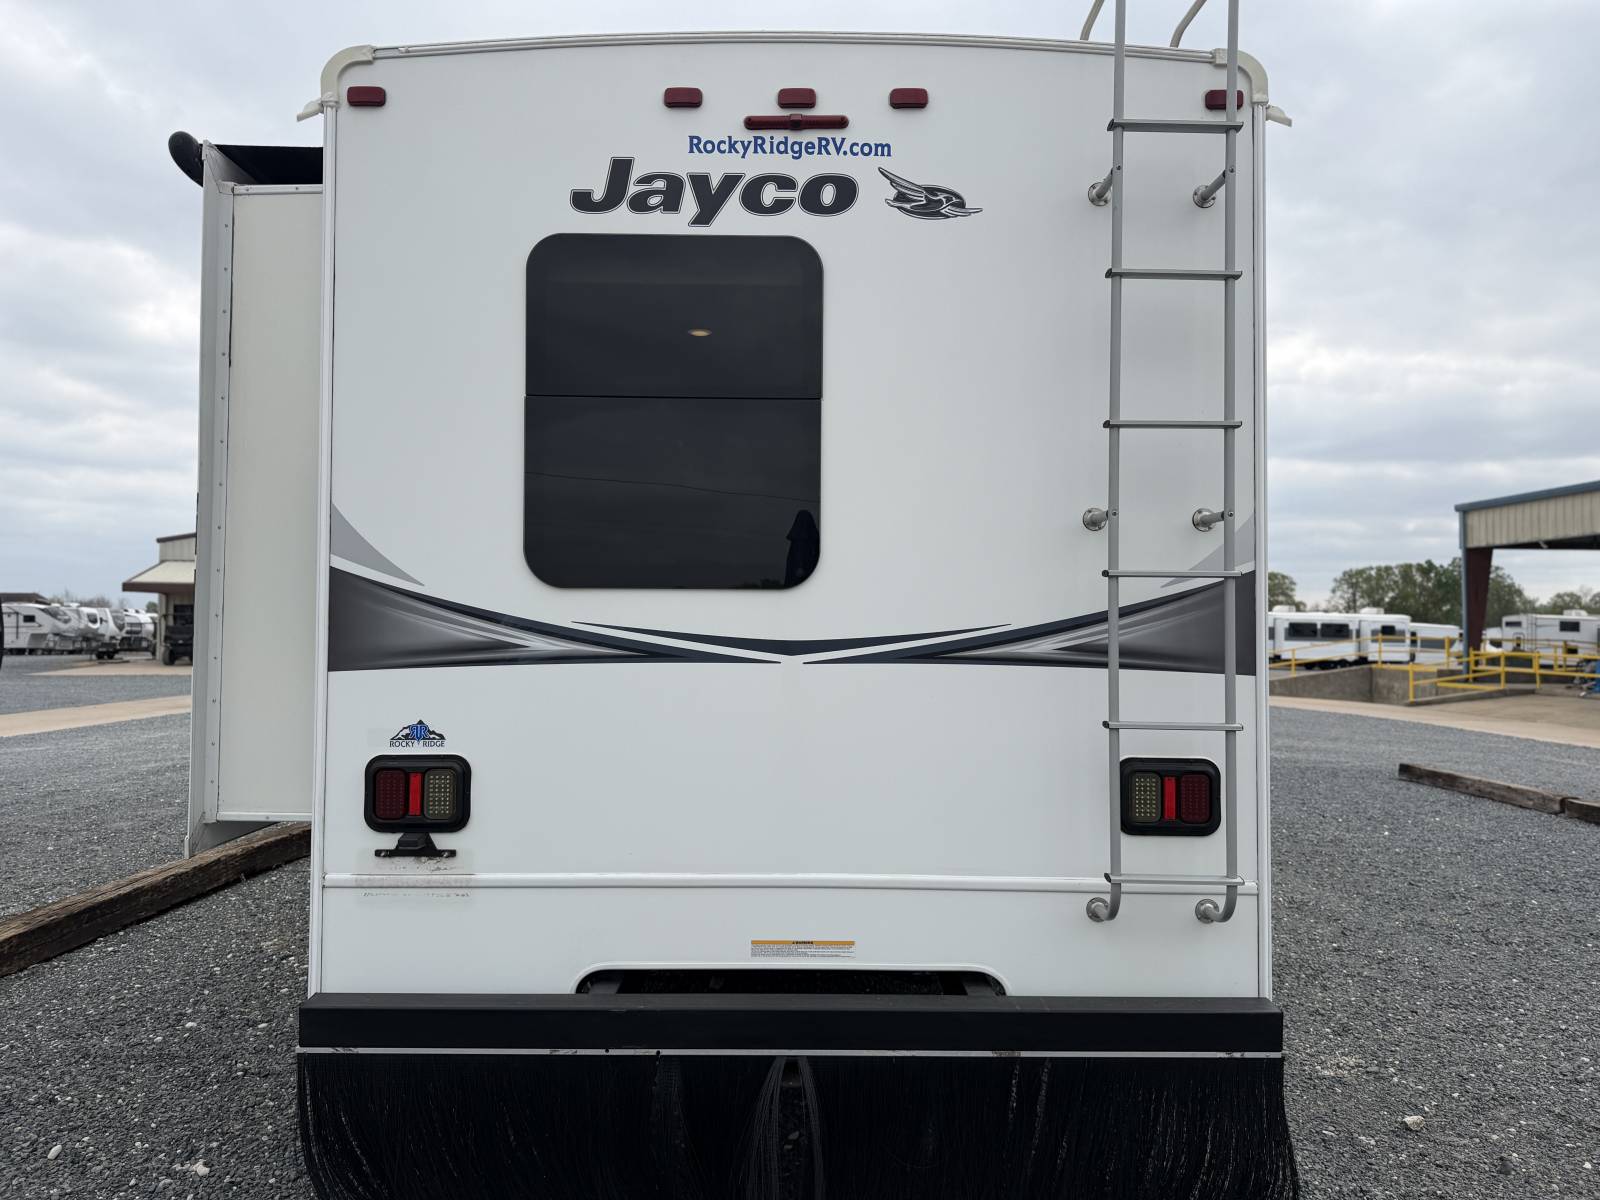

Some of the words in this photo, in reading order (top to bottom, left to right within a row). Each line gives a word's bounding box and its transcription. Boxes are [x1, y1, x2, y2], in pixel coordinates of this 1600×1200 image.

[688, 135, 892, 160] RockyRidgeRV.com
[570, 156, 859, 227] Jayco
[389, 740, 415, 748] ROCKY
[422, 740, 446, 748] RIDGE
